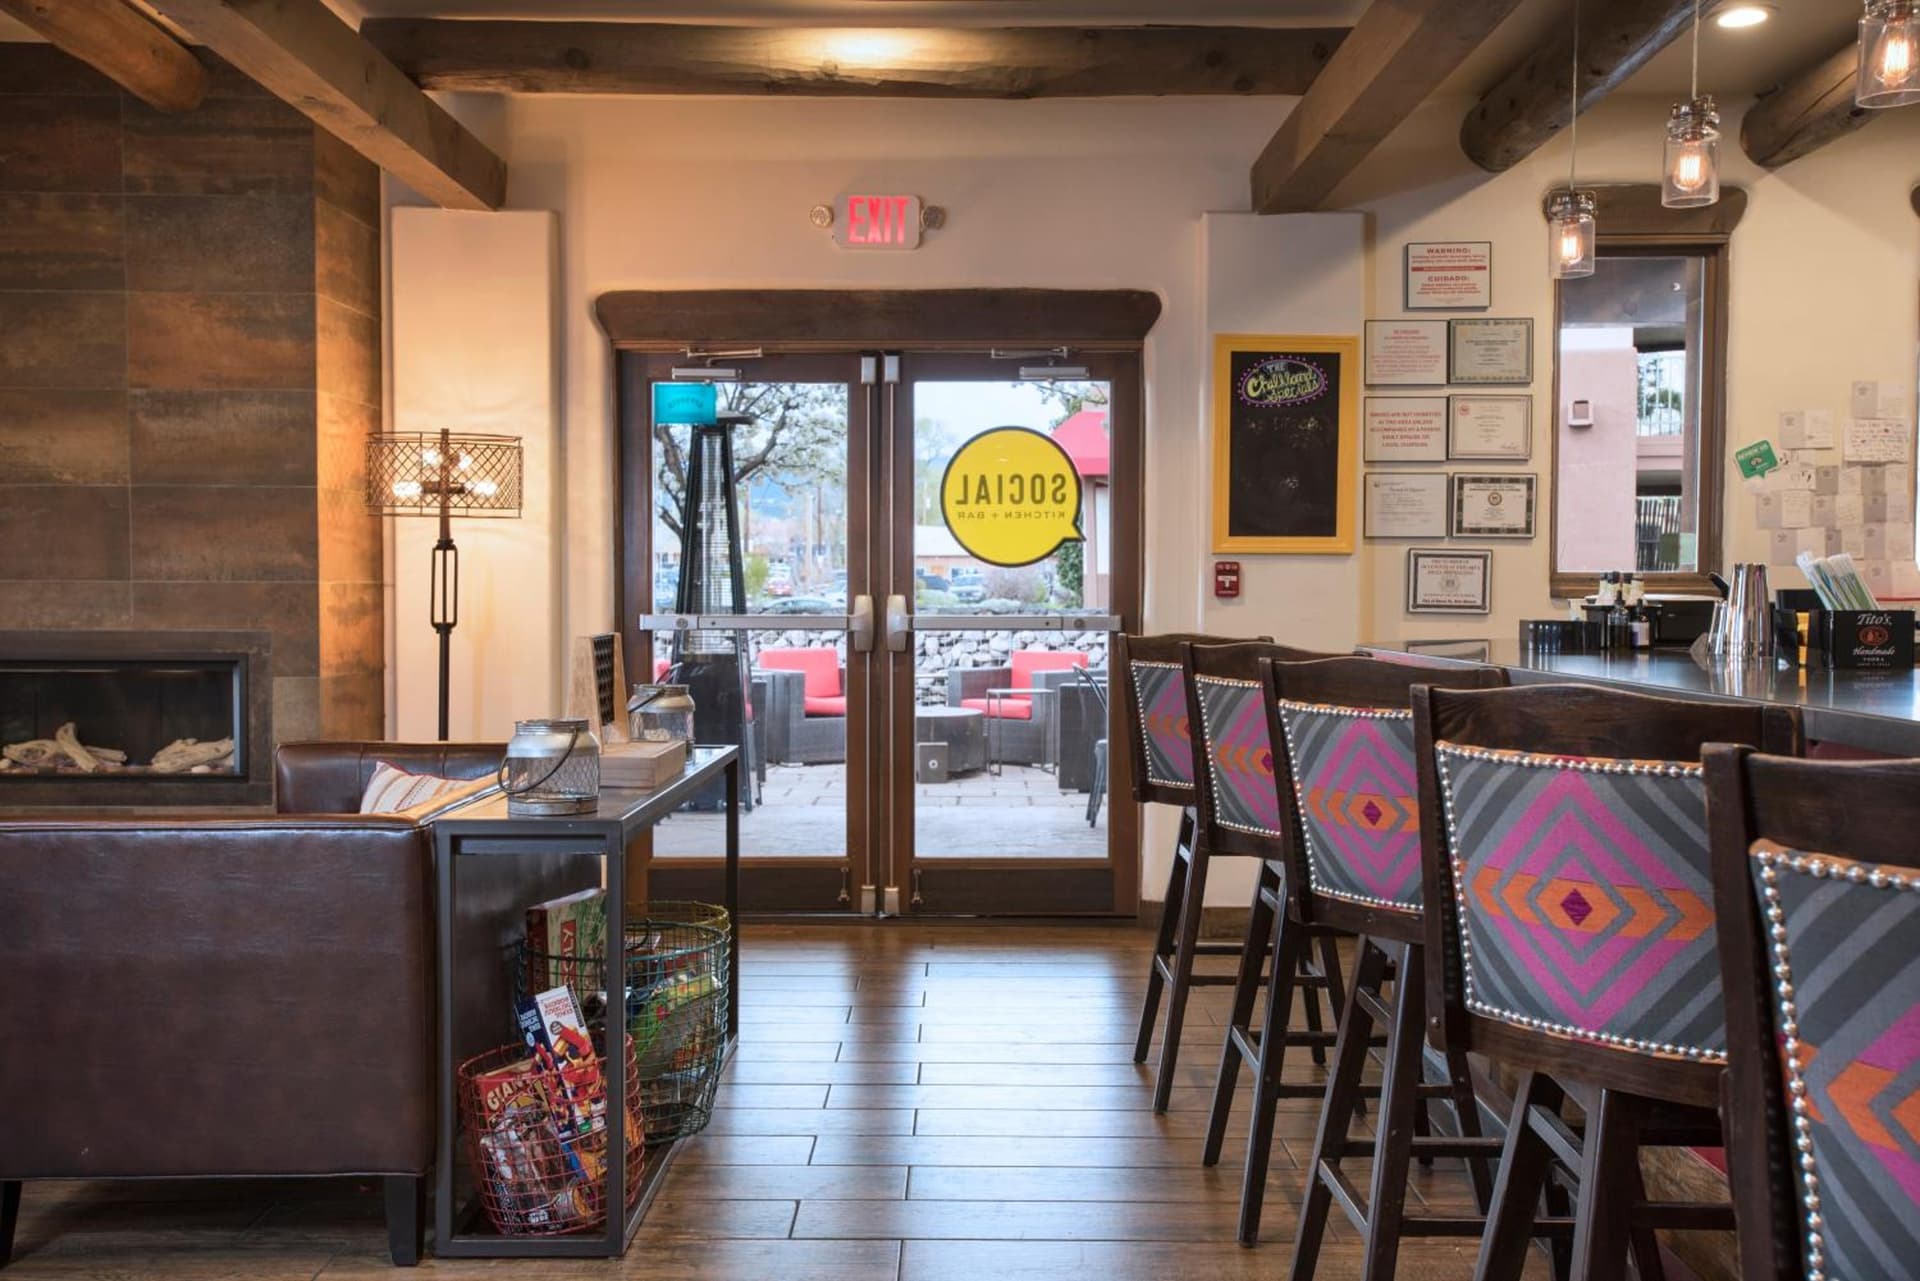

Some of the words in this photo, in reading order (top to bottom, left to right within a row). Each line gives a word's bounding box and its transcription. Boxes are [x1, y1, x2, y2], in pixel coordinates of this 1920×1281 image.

[847, 195, 909, 244] EXIT
[1264, 362, 1285, 375] THE
[1856, 613, 1892, 626] Tito's
[1853, 645, 1896, 656] Handmade
